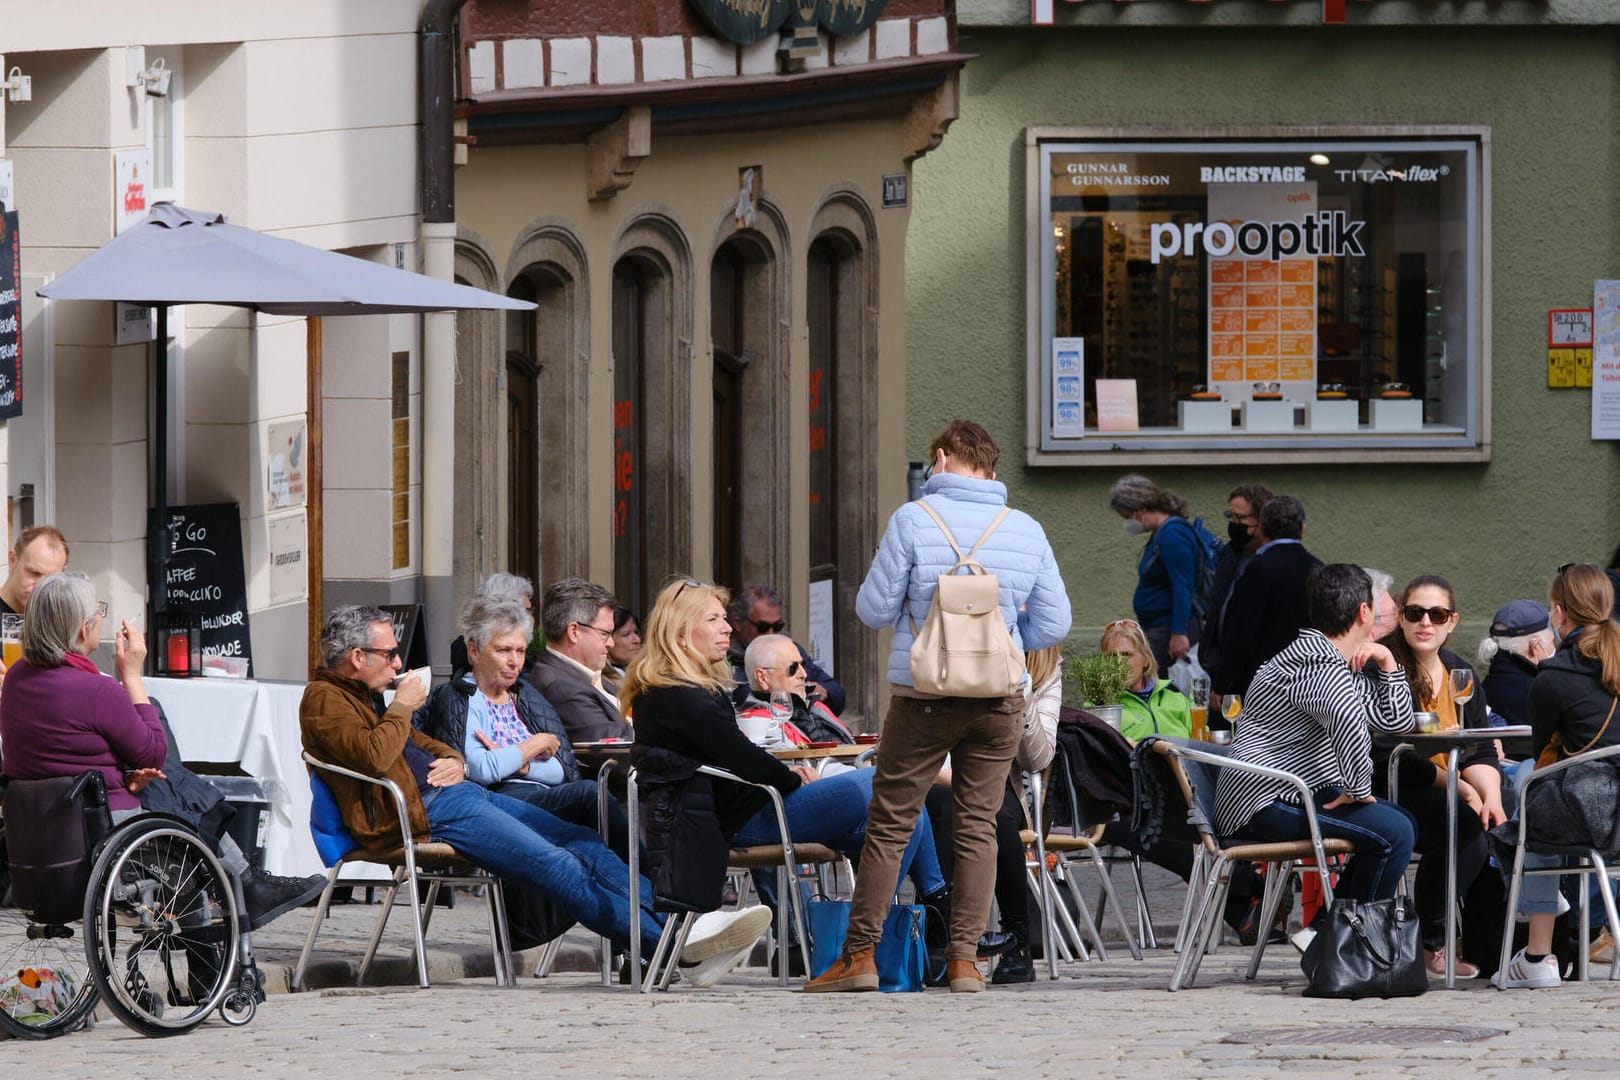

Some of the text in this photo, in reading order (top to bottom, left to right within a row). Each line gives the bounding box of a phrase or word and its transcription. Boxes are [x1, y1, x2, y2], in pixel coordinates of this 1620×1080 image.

[1067, 163, 1128, 174] GUNNAR
[1200, 166, 1306, 183] BACKSTAGE
[1072, 175, 1170, 186] GUNNARSSON
[166, 567, 197, 584] AFFEE
